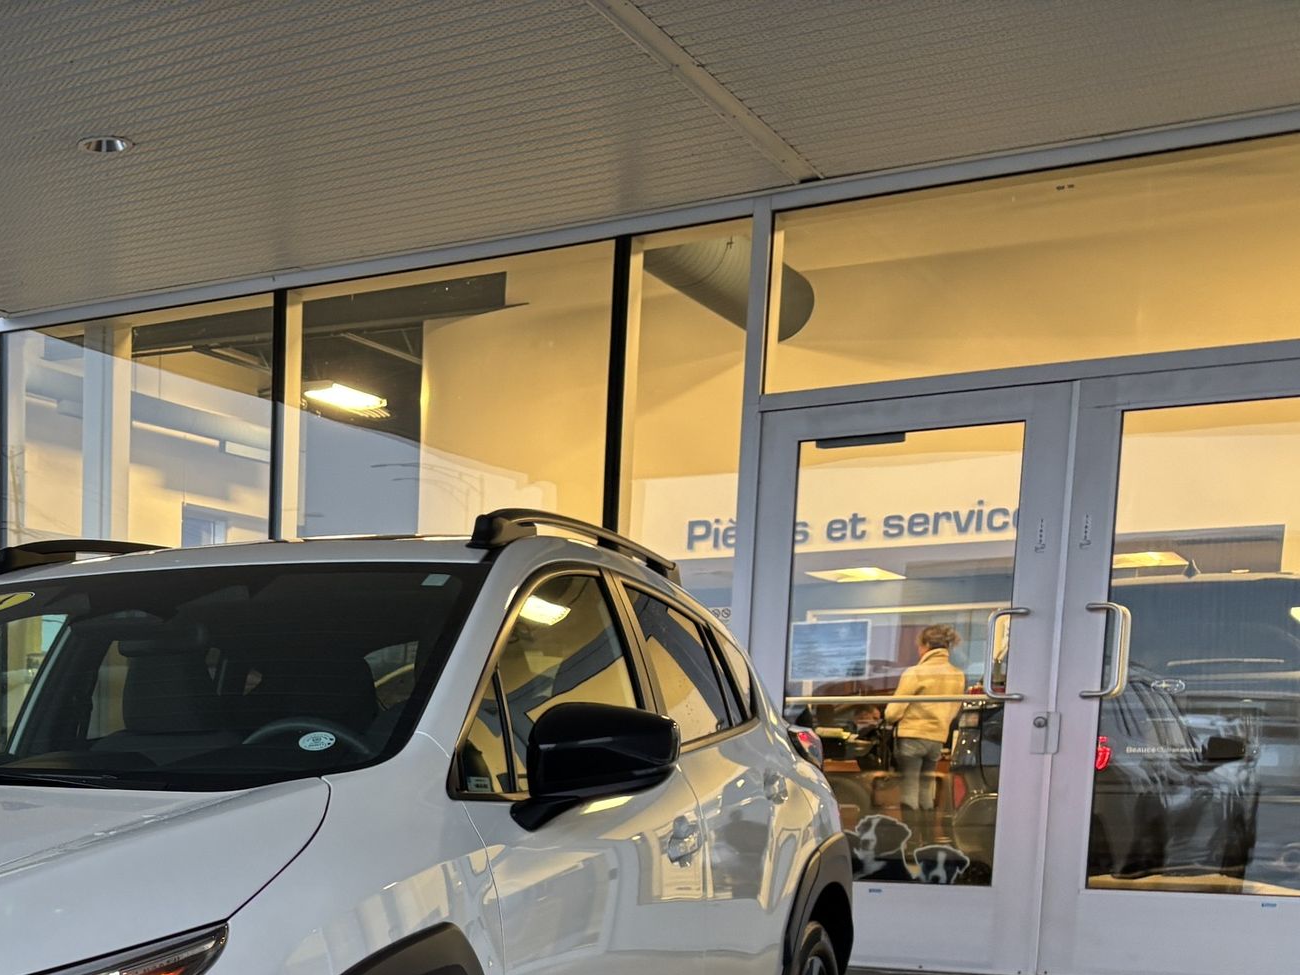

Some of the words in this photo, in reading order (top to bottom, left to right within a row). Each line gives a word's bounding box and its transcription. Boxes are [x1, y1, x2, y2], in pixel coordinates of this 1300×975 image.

[687, 517, 810, 550] Piès
[826, 512, 867, 541] et
[882, 499, 1020, 539] servic
